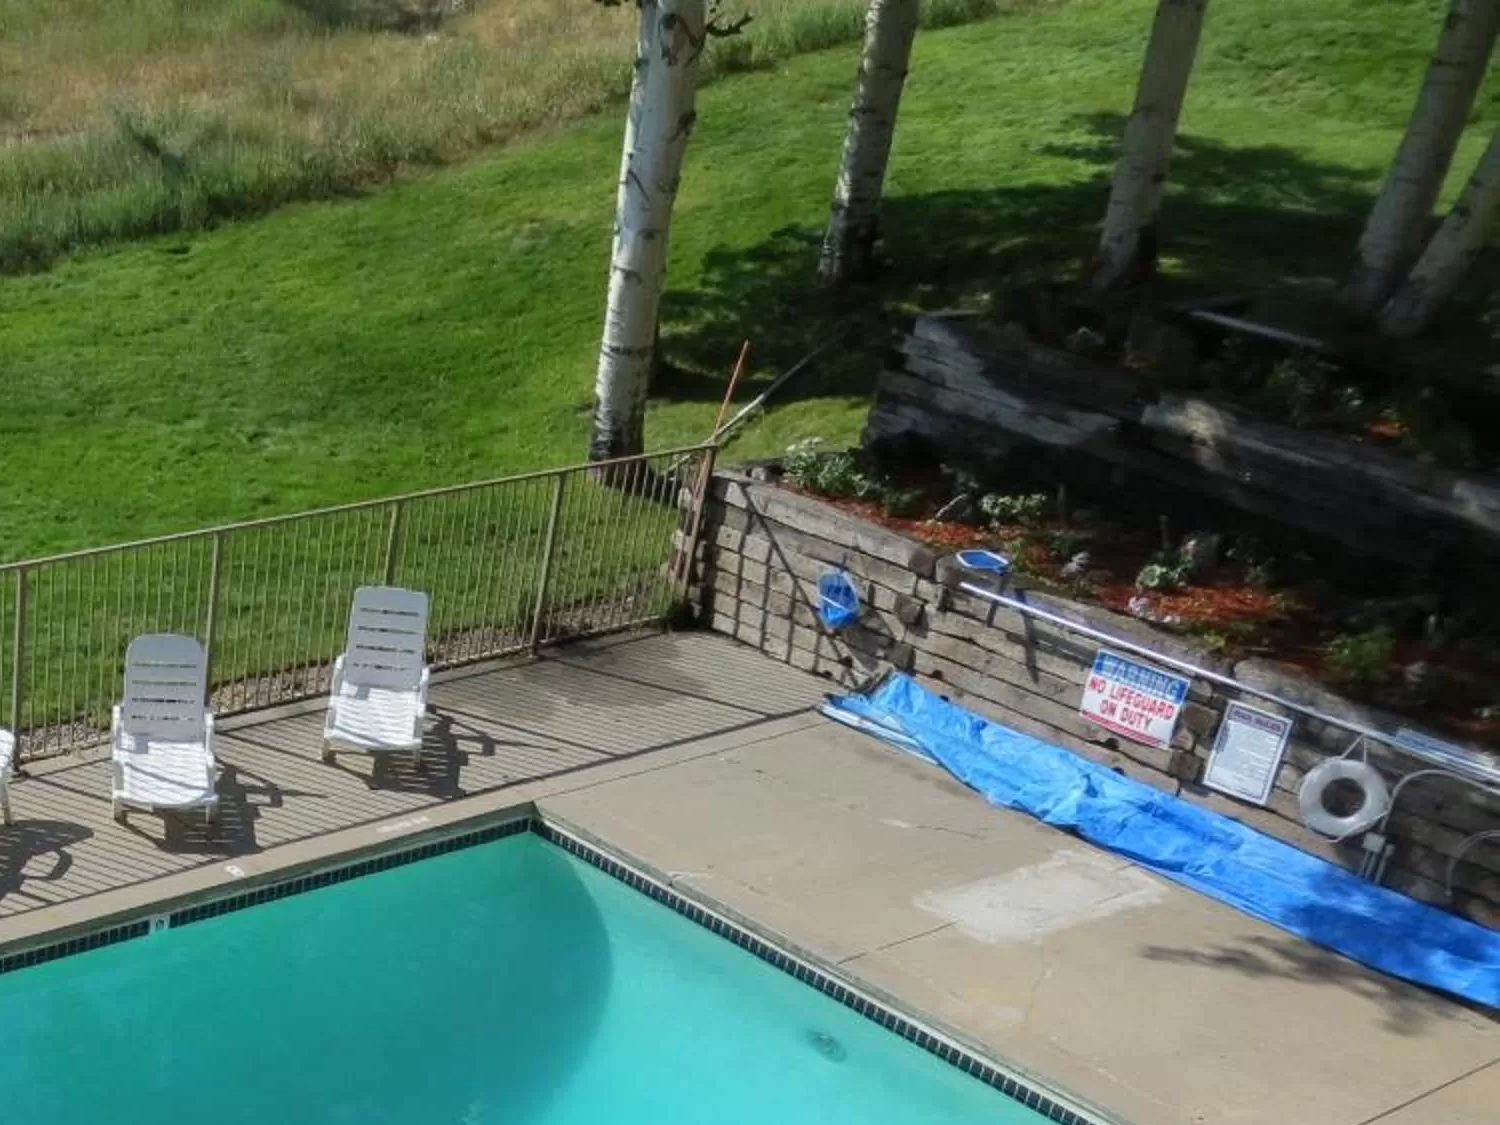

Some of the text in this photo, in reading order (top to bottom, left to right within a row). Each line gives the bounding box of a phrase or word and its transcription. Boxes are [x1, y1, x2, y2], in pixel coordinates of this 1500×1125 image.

[1090, 675, 1175, 720] NO LIFEGUARD
[1102, 659, 1179, 701] WARNING
[1100, 699, 1152, 730] ON DUTY
